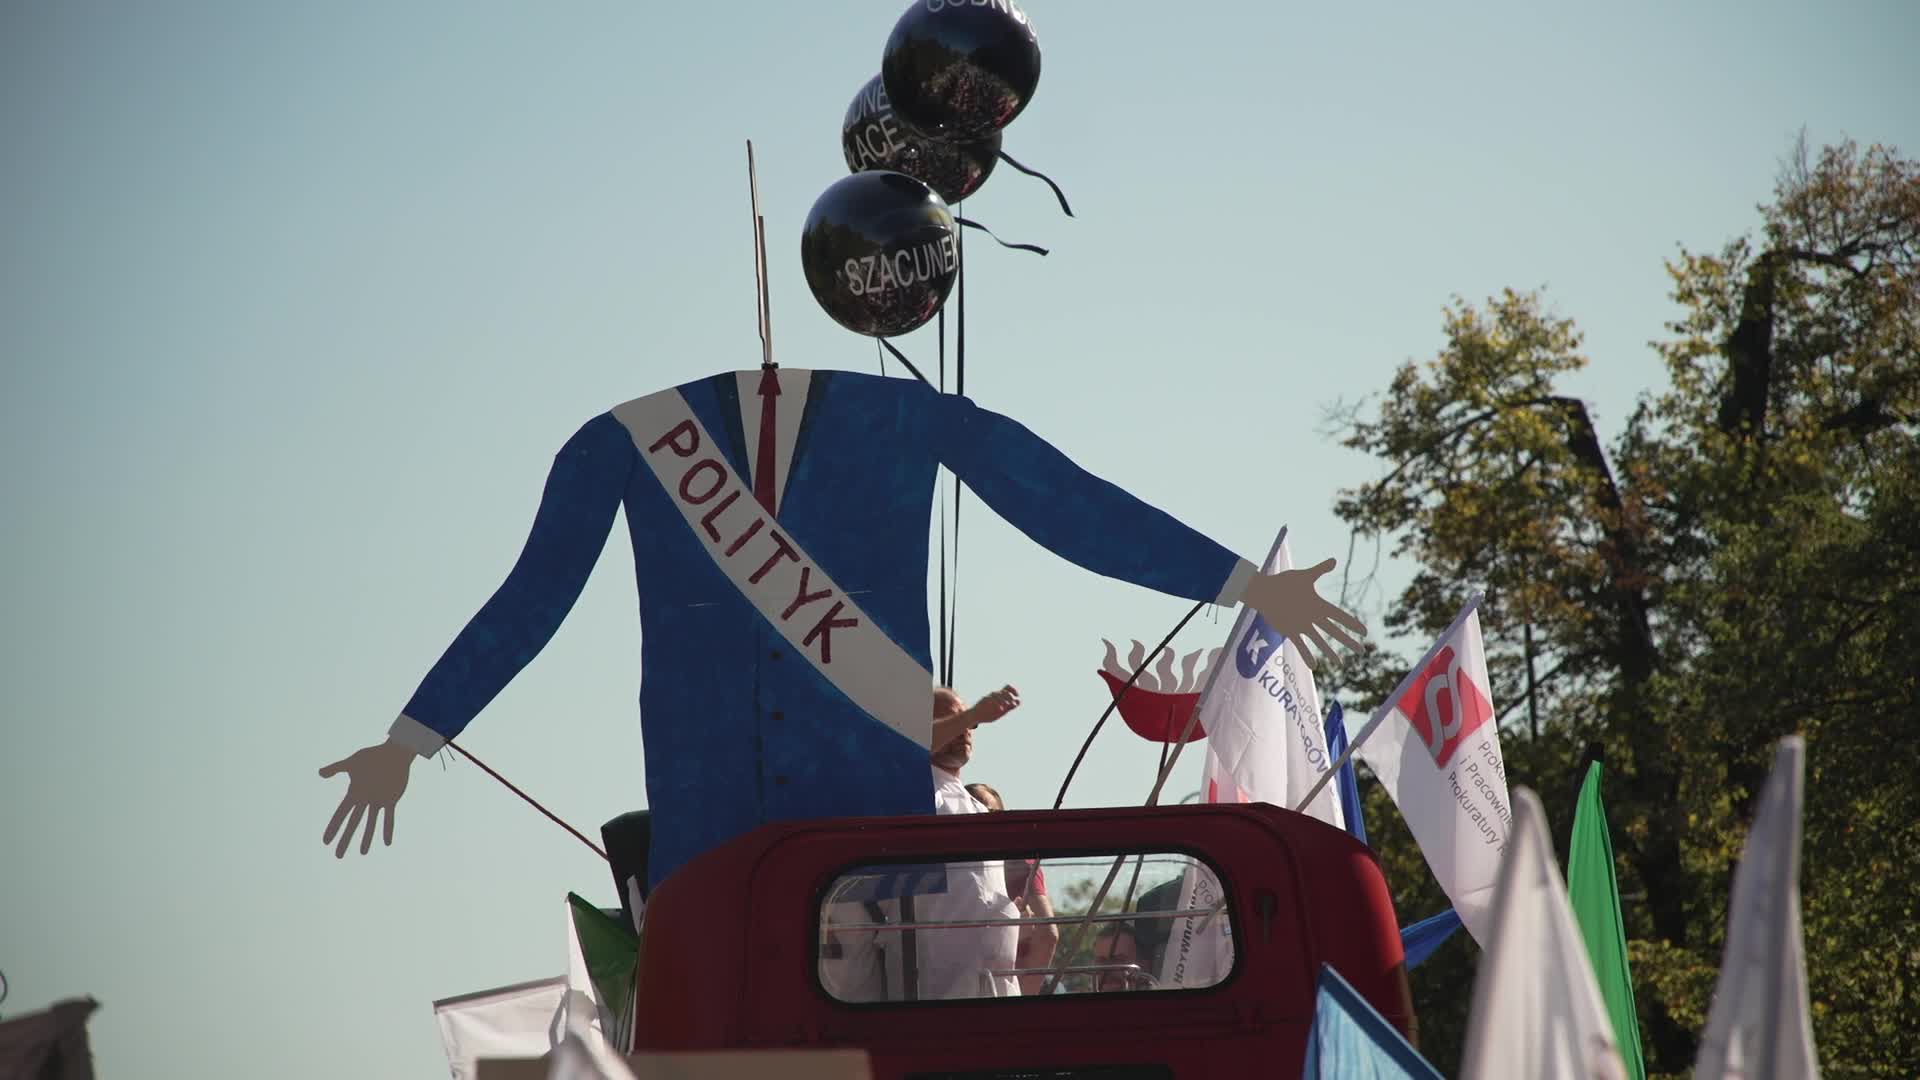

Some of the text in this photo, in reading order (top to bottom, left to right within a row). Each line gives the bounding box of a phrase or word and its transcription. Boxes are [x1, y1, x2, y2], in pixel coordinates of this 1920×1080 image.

[648, 419, 858, 664] POLITYK
[1460, 754, 1472, 765] i
[1448, 771, 1500, 844] Prokuratury
